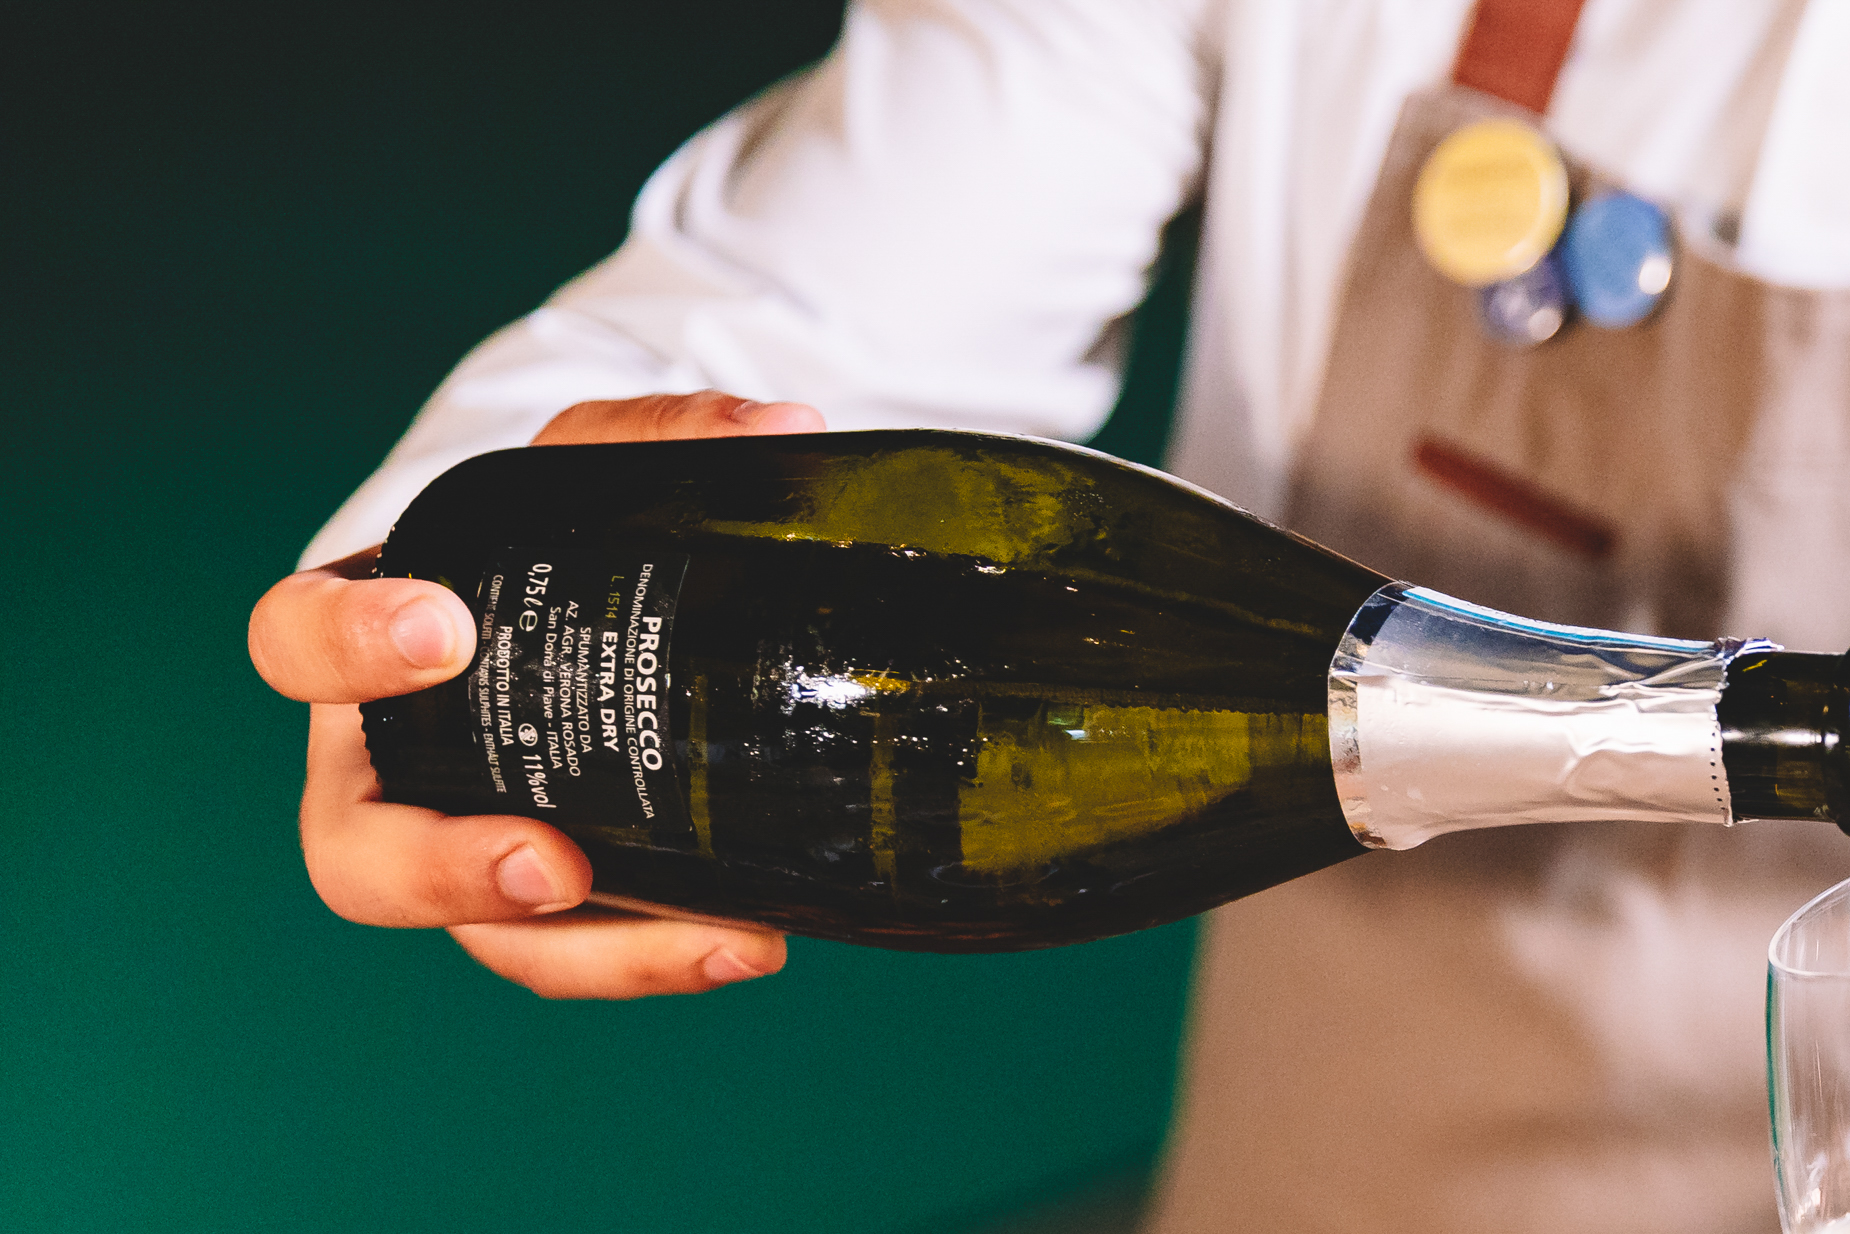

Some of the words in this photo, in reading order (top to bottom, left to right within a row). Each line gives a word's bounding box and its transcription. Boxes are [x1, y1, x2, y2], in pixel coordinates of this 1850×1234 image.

[547, 606, 562, 629] San
[565, 600, 579, 621] AZ.
[605, 591, 620, 619] 1514
[624, 564, 653, 664] DENOMINAZIONE
[496, 625, 513, 692] PRODOTTO
[543, 671, 555, 682] di
[576, 627, 592, 731] SPUMANTIZZATO
[598, 631, 618, 701] EXTRA
[624, 668, 635, 681] DI
[496, 694, 510, 707] IN
[543, 686, 554, 719] Piave
[559, 662, 572, 718] VERONA
[623, 684, 636, 734] ORIGINE
[636, 616, 662, 770] PROSECCO
[497, 709, 515, 746] ITALIA
[580, 734, 593, 753] DA
[600, 708, 619, 752] DRY
[546, 731, 563, 769] ITALIA
[562, 721, 581, 777] ROSADO
[627, 737, 655, 819] CONTROLLATA
